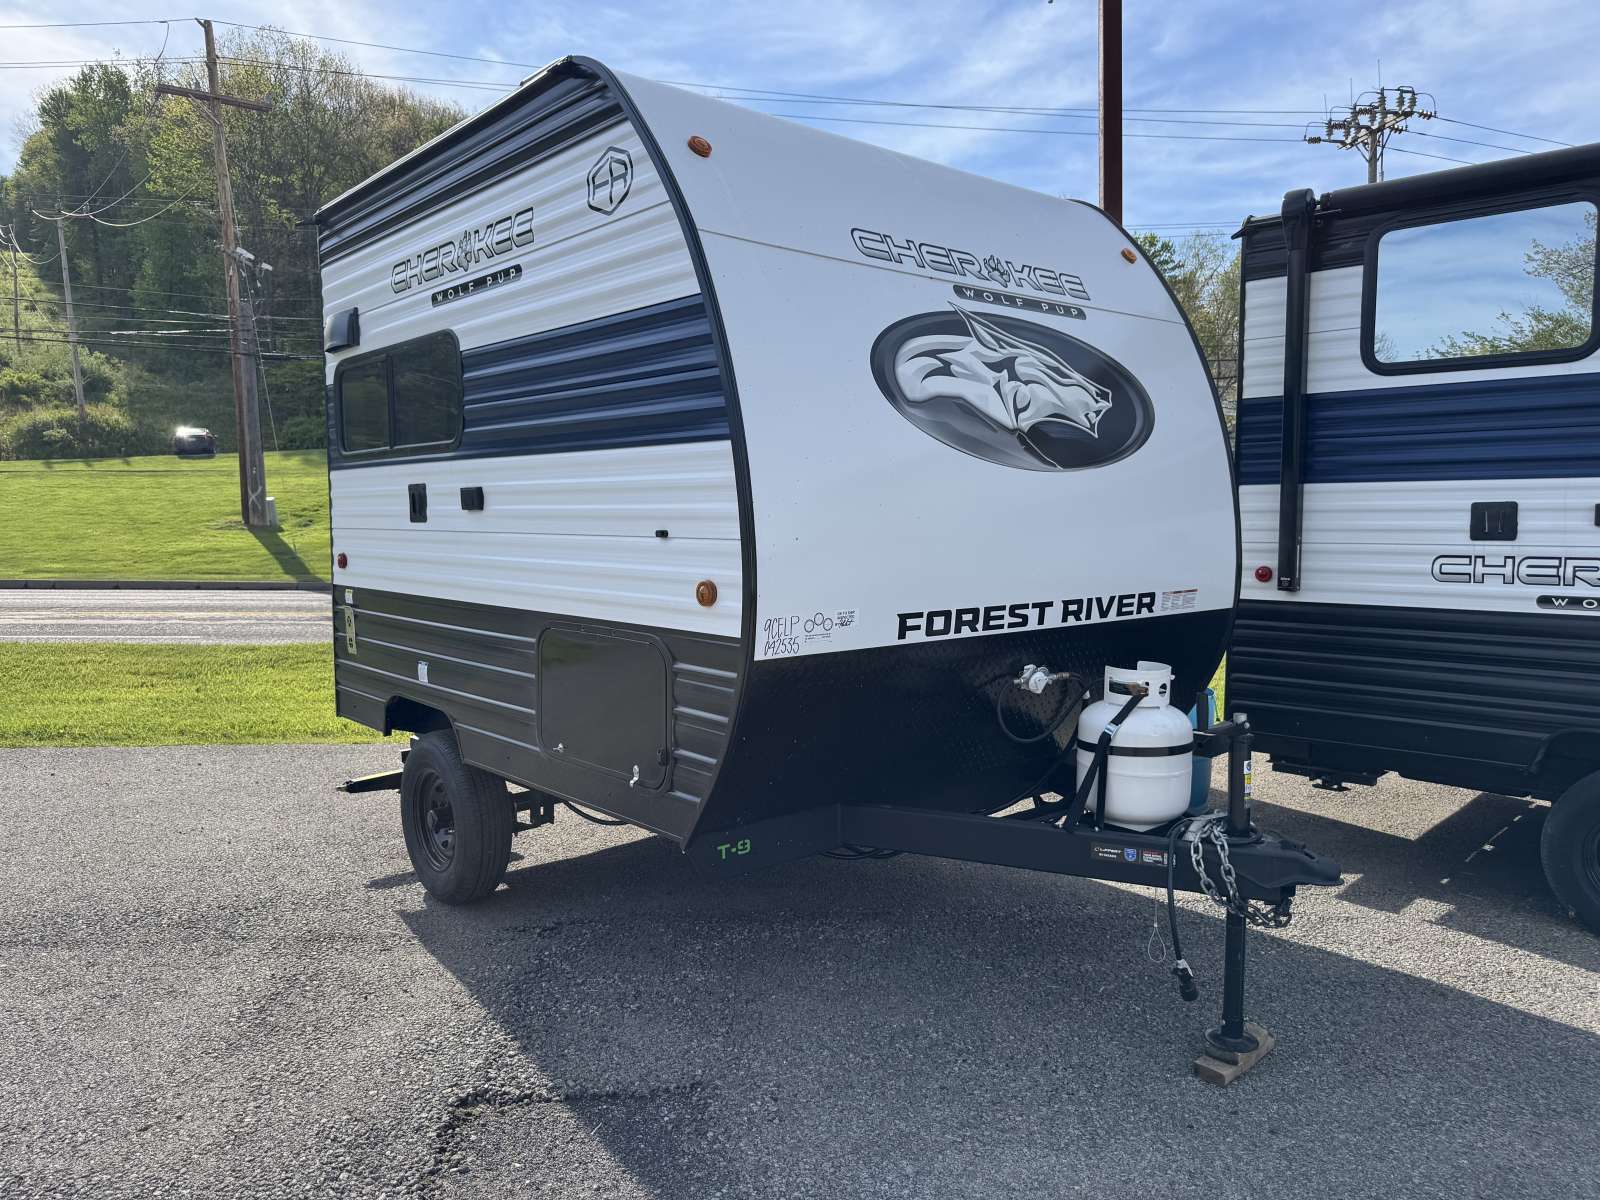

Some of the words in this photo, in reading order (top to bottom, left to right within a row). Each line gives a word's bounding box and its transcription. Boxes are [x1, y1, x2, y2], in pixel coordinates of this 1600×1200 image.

[436, 282, 475, 302] WOLF
[486, 268, 517, 287] PUP
[963, 288, 1024, 306] WOLF
[1041, 303, 1079, 317] PUP
[897, 601, 1054, 640] FOREST
[1061, 592, 1156, 624] RIVER
[717, 839, 751, 859] T-9
